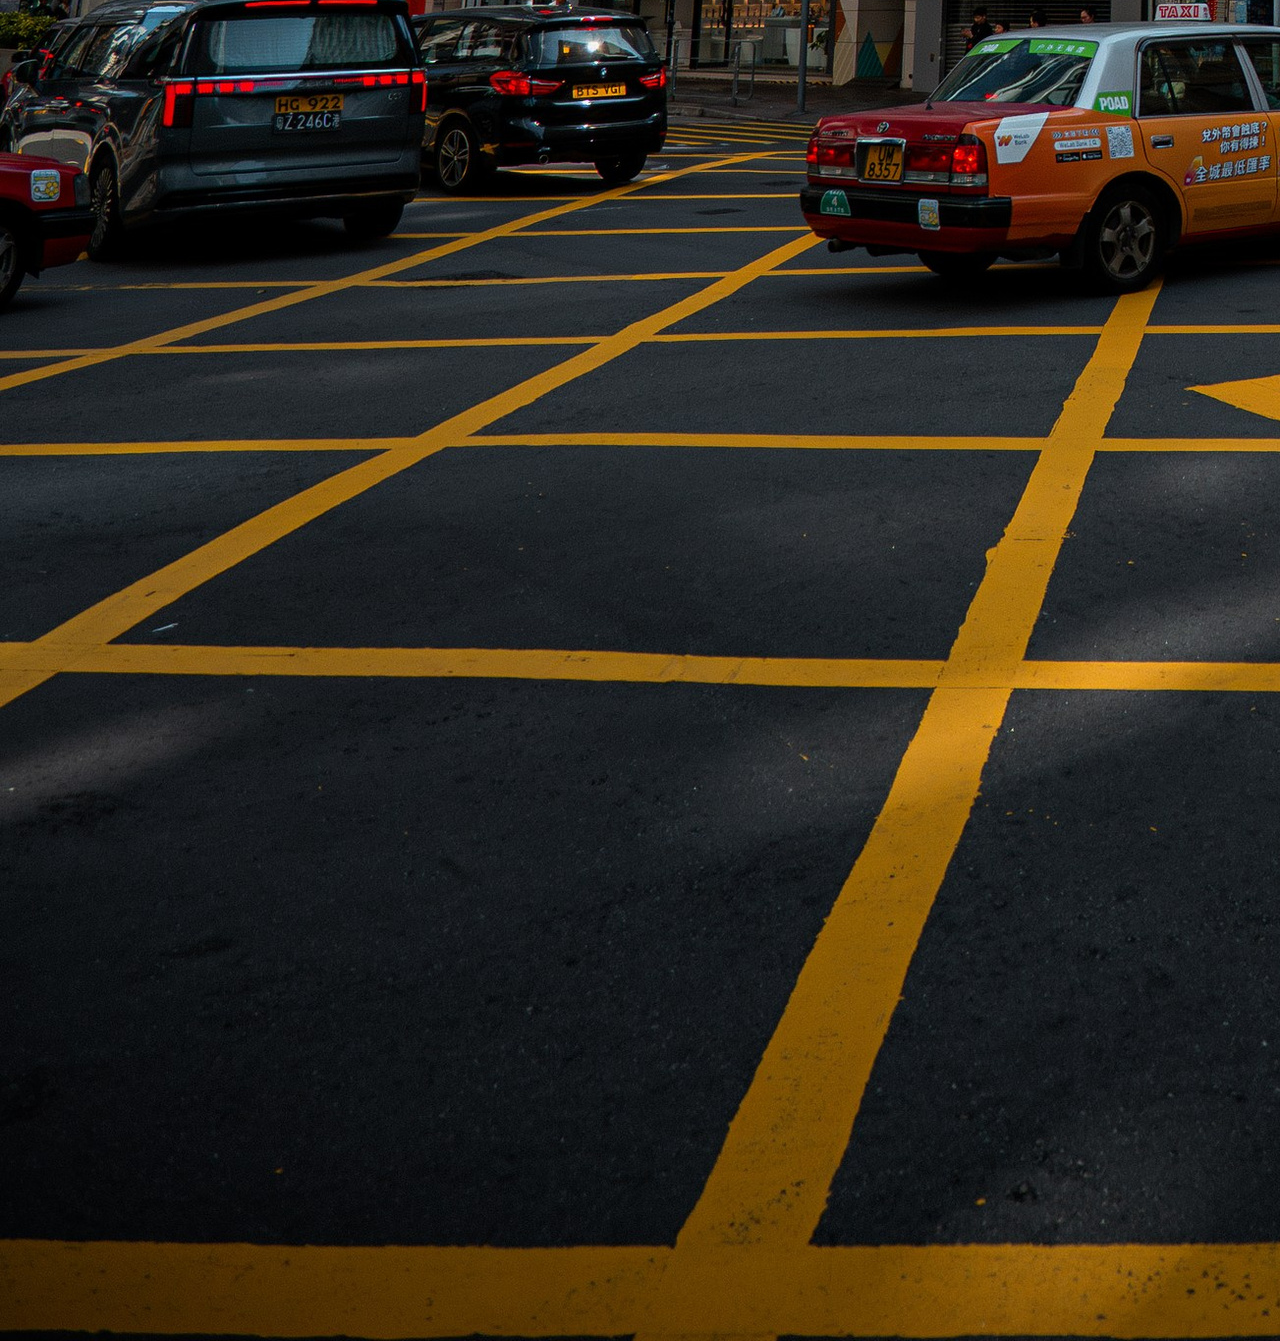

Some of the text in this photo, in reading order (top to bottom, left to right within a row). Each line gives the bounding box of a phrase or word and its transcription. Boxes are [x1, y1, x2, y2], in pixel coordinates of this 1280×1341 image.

[1159, 4, 1199, 18] TAXI
[576, 85, 599, 97] BTS
[277, 95, 341, 113] HG 922
[1099, 96, 1129, 111] POAD
[877, 146, 895, 163] UM
[867, 162, 900, 180] 8357
[1195, 155, 1272, 184] 全城最低匯率
[832, 196, 838, 207] 4
